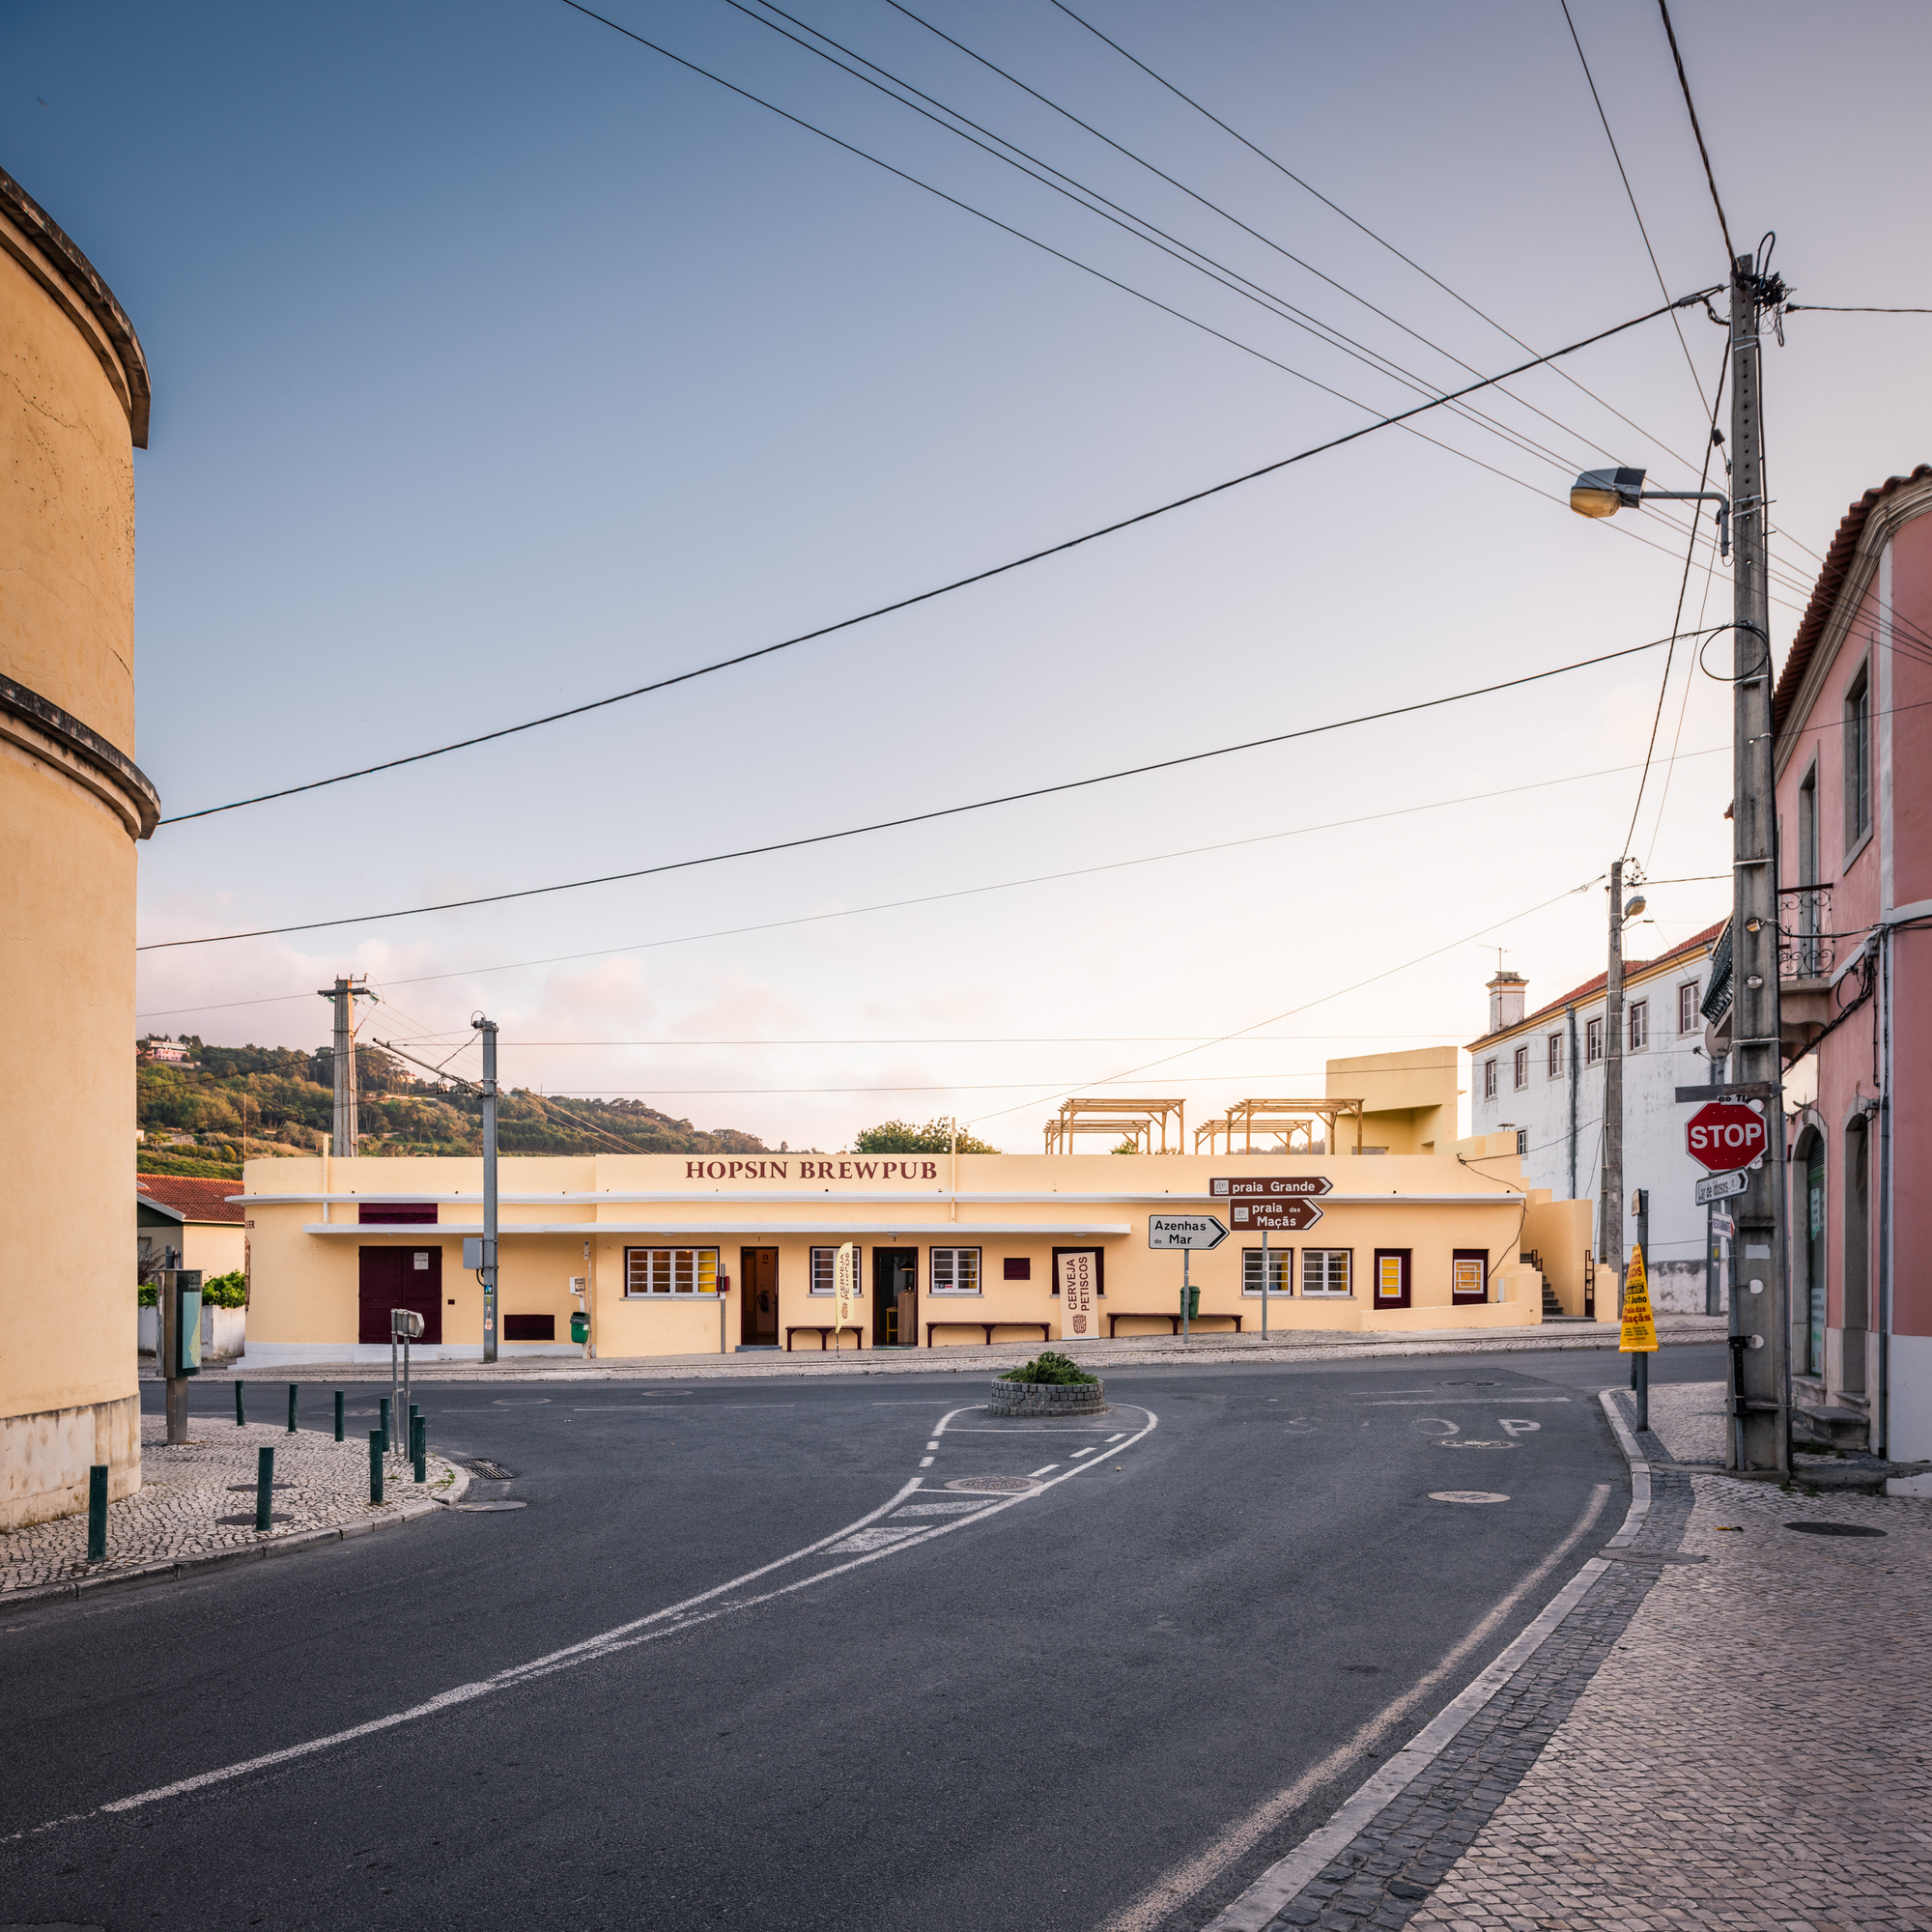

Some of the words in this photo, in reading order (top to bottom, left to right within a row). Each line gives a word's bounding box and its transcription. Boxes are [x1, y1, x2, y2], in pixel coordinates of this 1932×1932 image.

[1690, 1123, 1762, 1149] STOP
[685, 1161, 788, 1179] HOPSIN
[799, 1161, 937, 1179] BREWPUB
[1232, 1181, 1264, 1194] praia
[1270, 1181, 1315, 1192] Grande
[1697, 1185, 1706, 1200] Lar
[1706, 1182, 1712, 1198] de
[1713, 1179, 1728, 1197] idosos
[1252, 1203, 1283, 1214] praia
[1154, 1220, 1207, 1231] Azenhas
[1257, 1216, 1296, 1229] Maçãs
[1169, 1235, 1192, 1244] Mar
[1066, 1259, 1077, 1310] CERVEJA
[1078, 1256, 1090, 1311] PETISCOS
